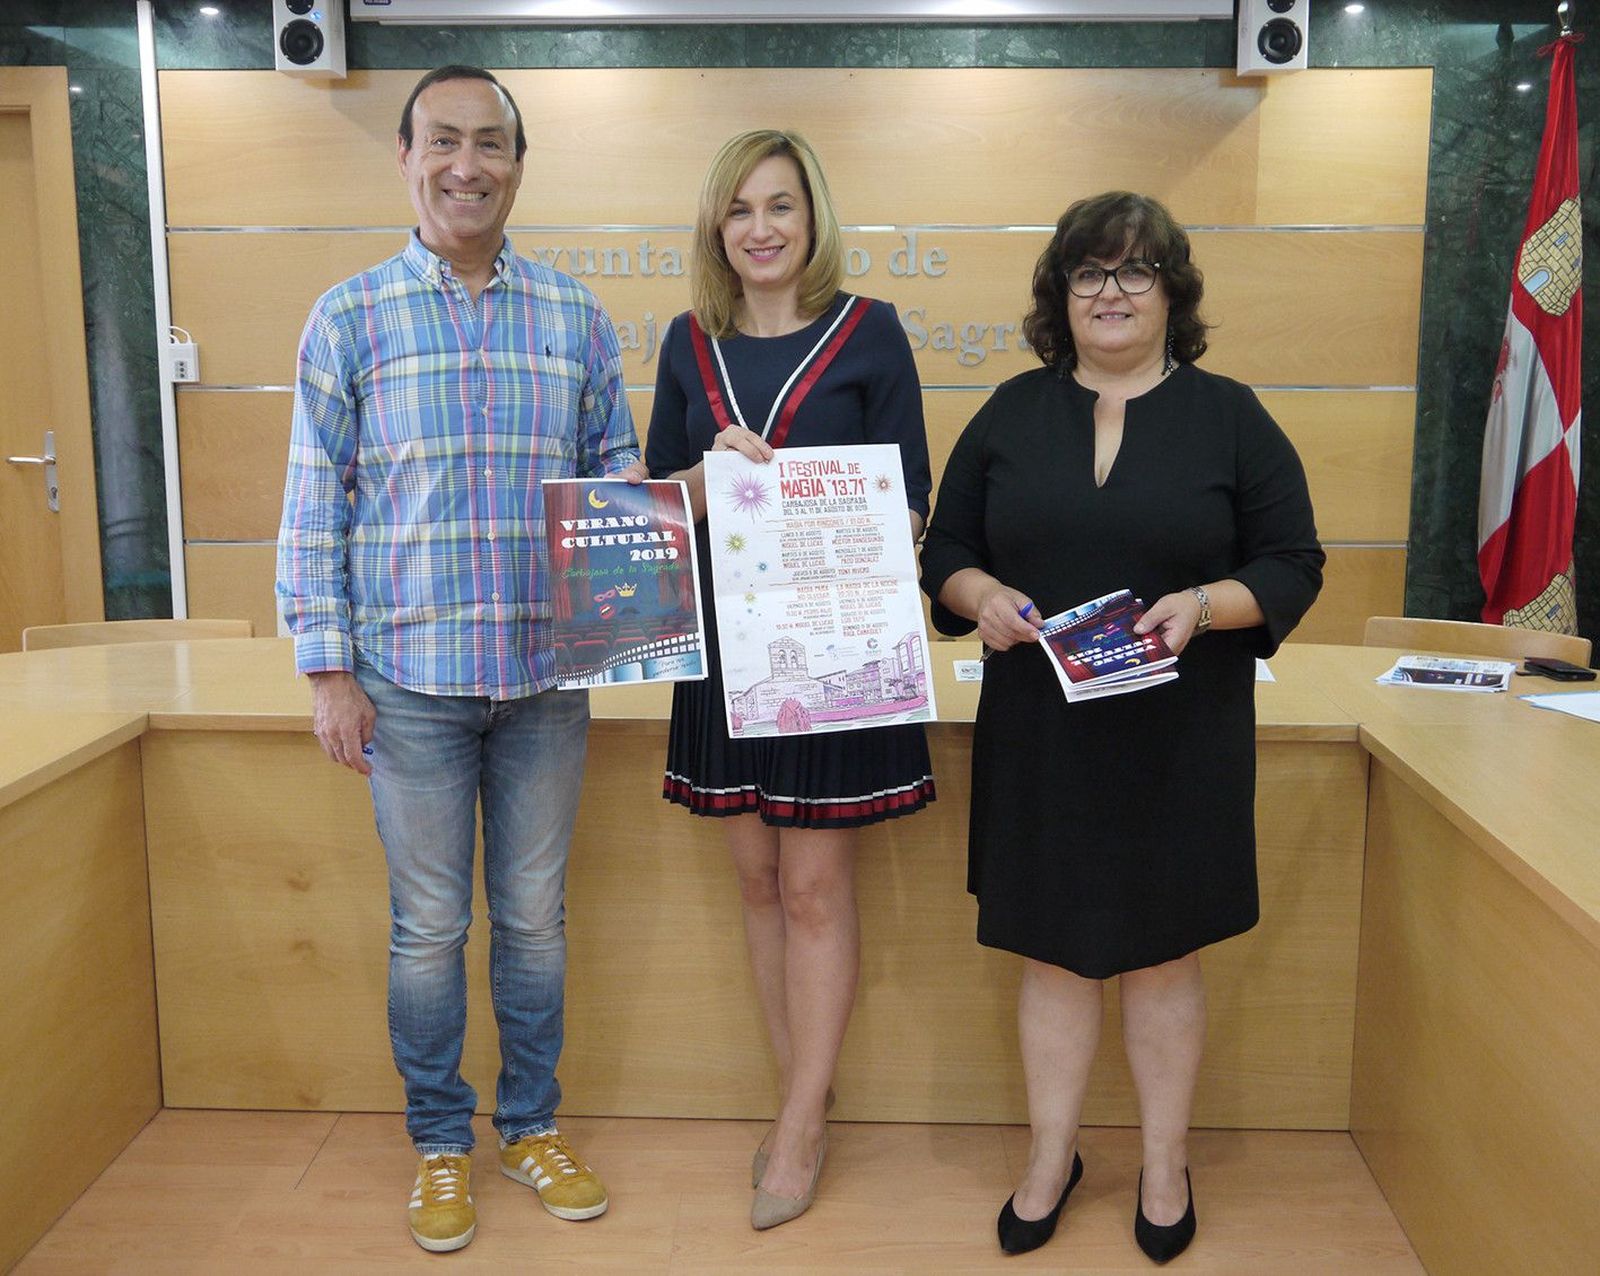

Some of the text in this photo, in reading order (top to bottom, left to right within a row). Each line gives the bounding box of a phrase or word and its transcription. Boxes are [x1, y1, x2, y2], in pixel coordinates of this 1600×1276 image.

[888, 229, 949, 278] de
[901, 306, 1029, 367] Sagr
[778, 459, 861, 478] I FESTIVAL DE
[780, 478, 826, 499] MAGIA
[782, 496, 867, 508] CARBAJOSA DE LA SAGRADA
[783, 508, 794, 516] DEL
[800, 507, 809, 515] AL
[815, 506, 822, 514] DE
[823, 505, 846, 514] AGOSTO
[846, 504, 854, 513] DE
[560, 515, 649, 531] VERANO
[561, 531, 676, 549] CULTURAL
[630, 547, 679, 561] 2019
